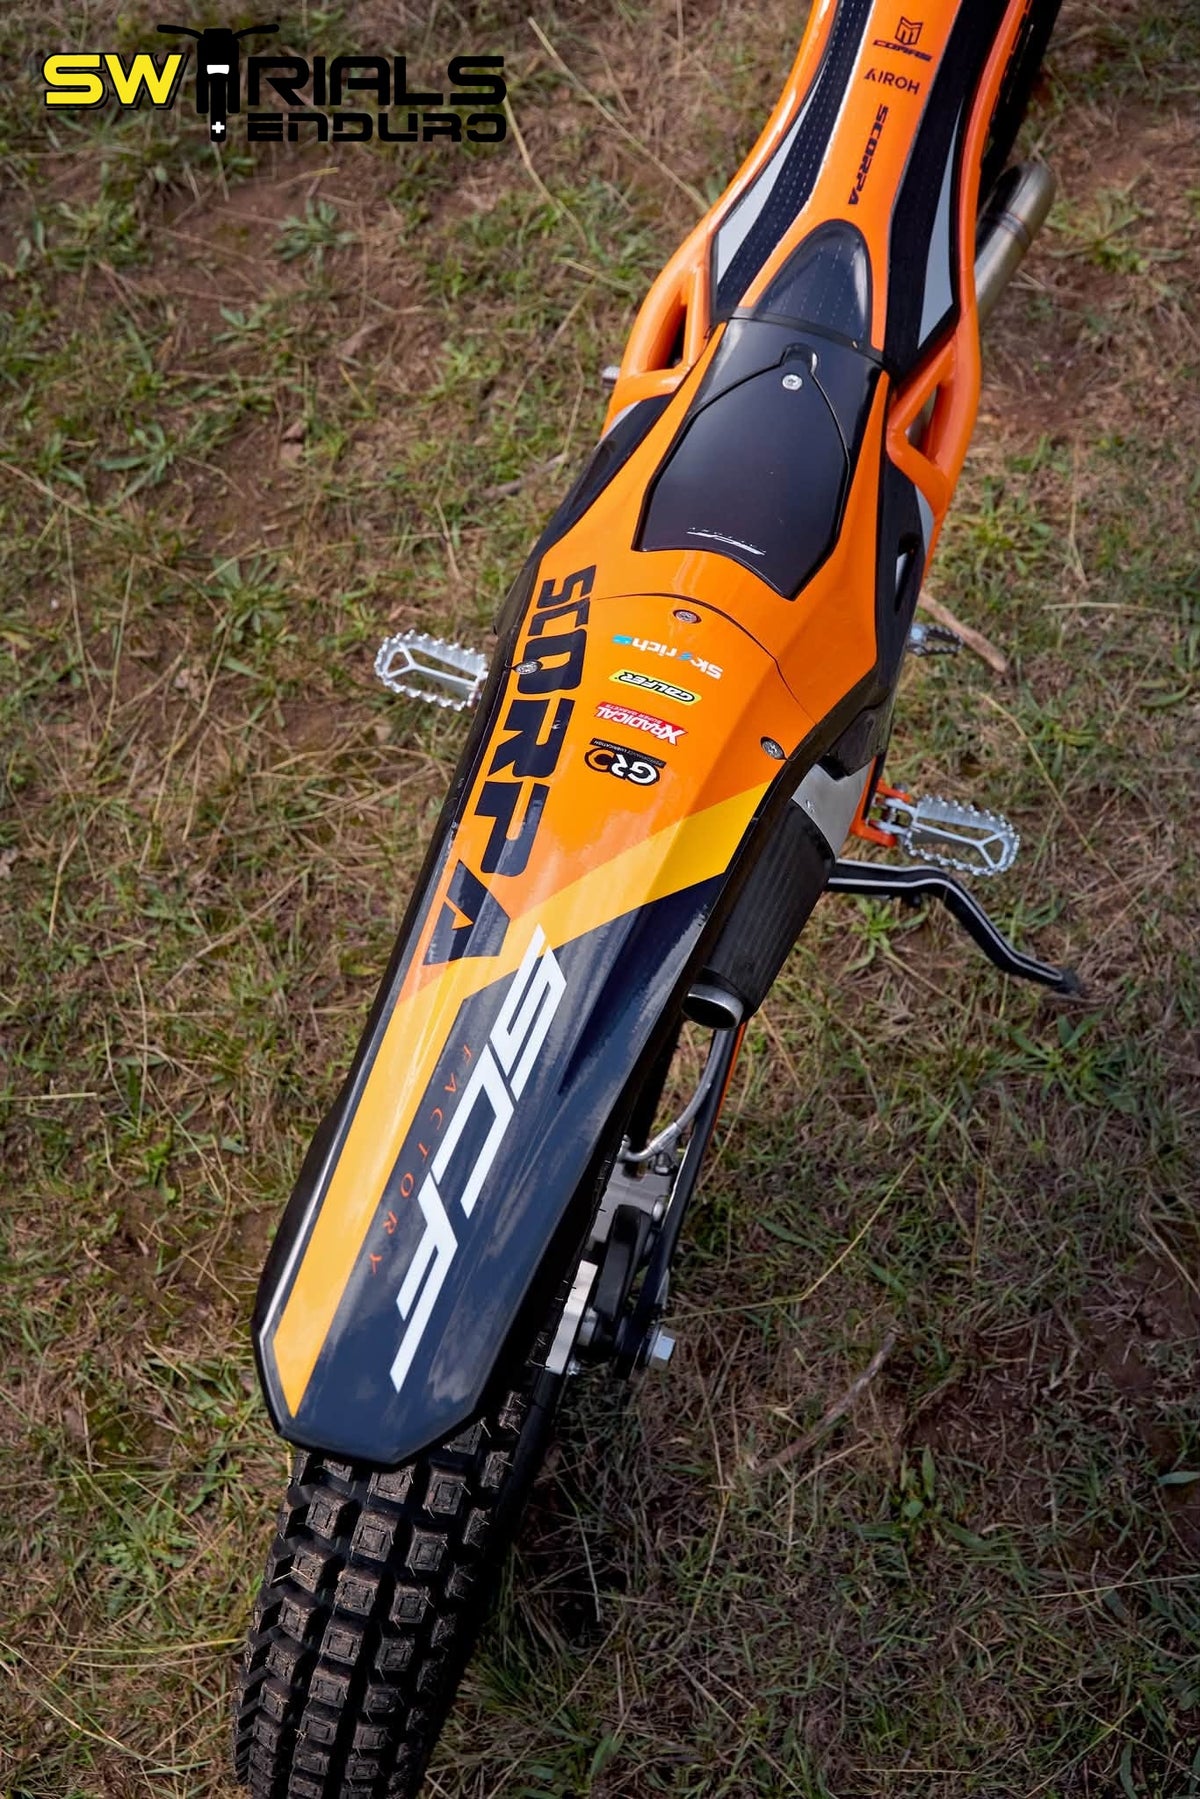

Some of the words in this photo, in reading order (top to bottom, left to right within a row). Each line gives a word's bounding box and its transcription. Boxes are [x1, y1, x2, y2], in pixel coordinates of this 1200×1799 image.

[864, 67, 920, 95] AIROH
[848, 104, 889, 205] SCORPA
[618, 671, 695, 702] GALFER
[423, 565, 596, 965] SCORPA
[368, 1043, 474, 1276] FACTORY
